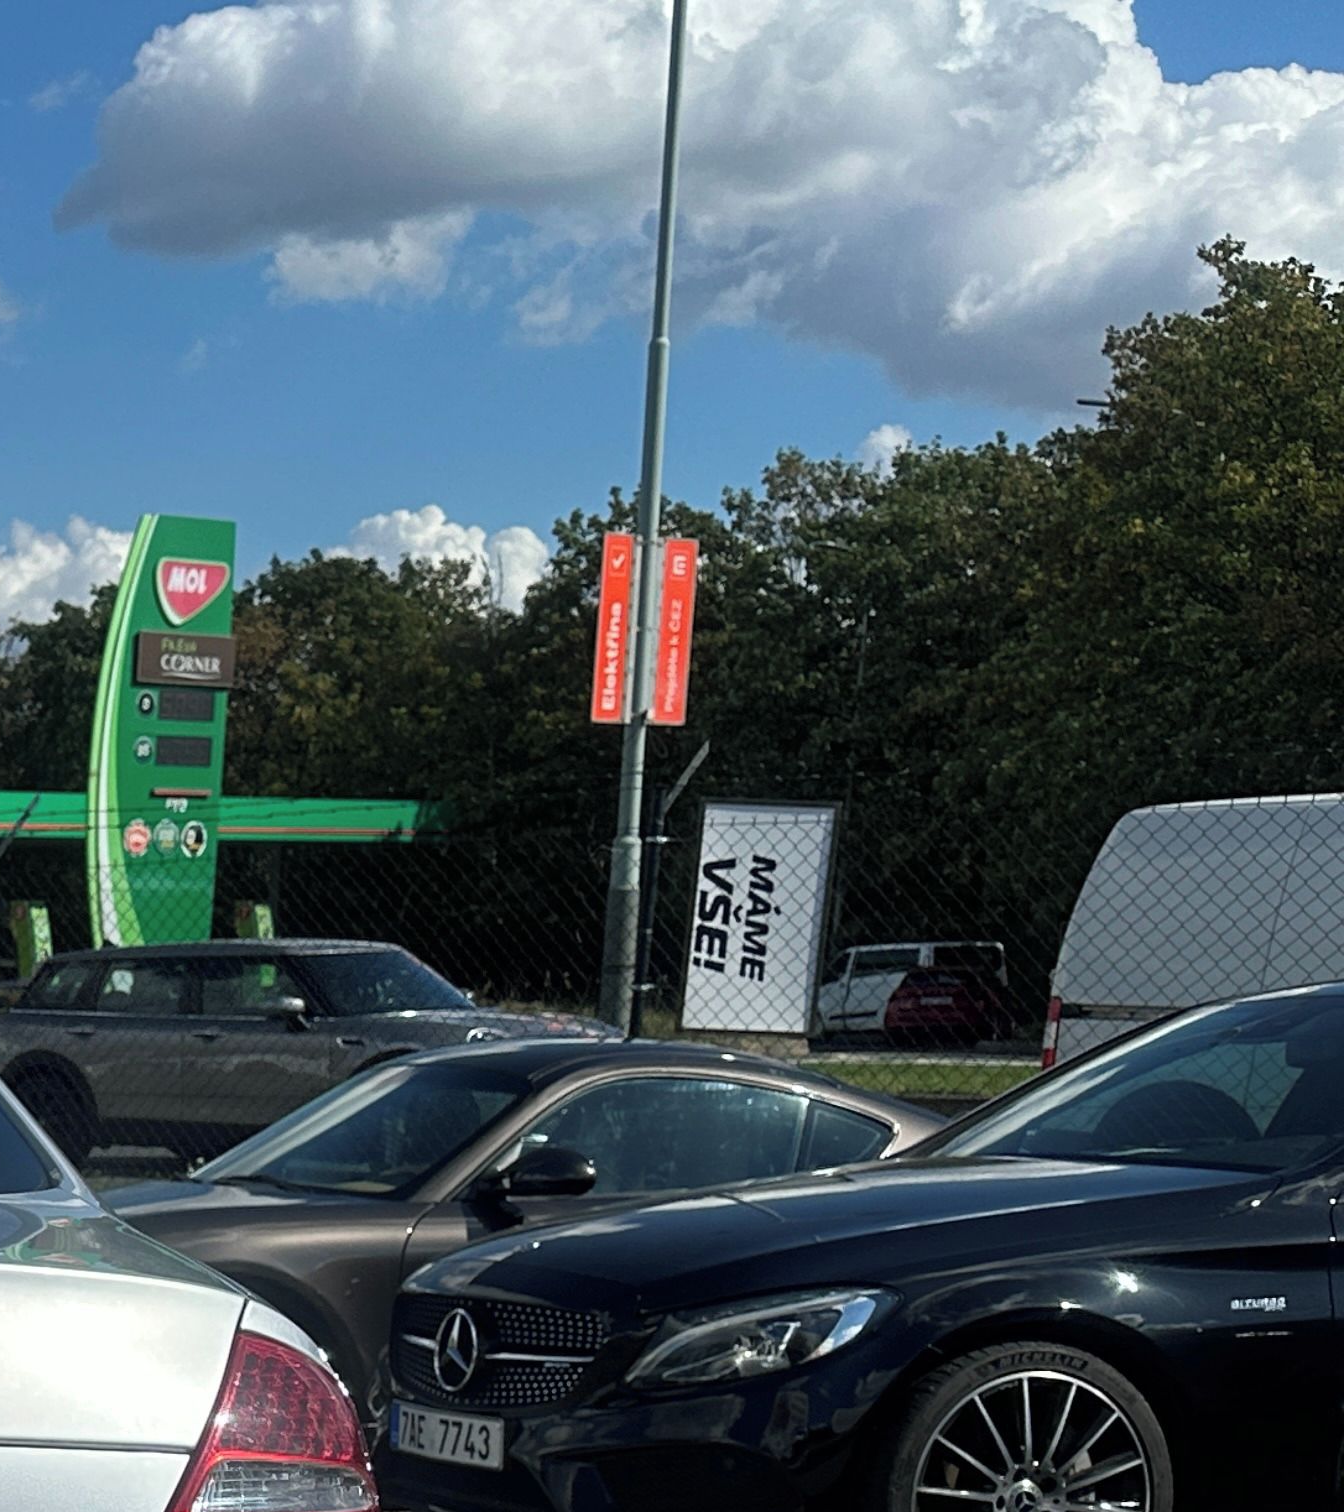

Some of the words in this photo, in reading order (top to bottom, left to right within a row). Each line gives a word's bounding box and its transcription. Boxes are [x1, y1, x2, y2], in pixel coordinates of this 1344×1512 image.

[167, 566, 208, 594] MOL
[160, 654, 221, 674] CORNER
[601, 602, 623, 711] Elektřina
[692, 858, 743, 974] VŠE!
[739, 854, 781, 982] MÁME
[401, 1410, 426, 1450] 7AE
[438, 1419, 490, 1460] 7743
